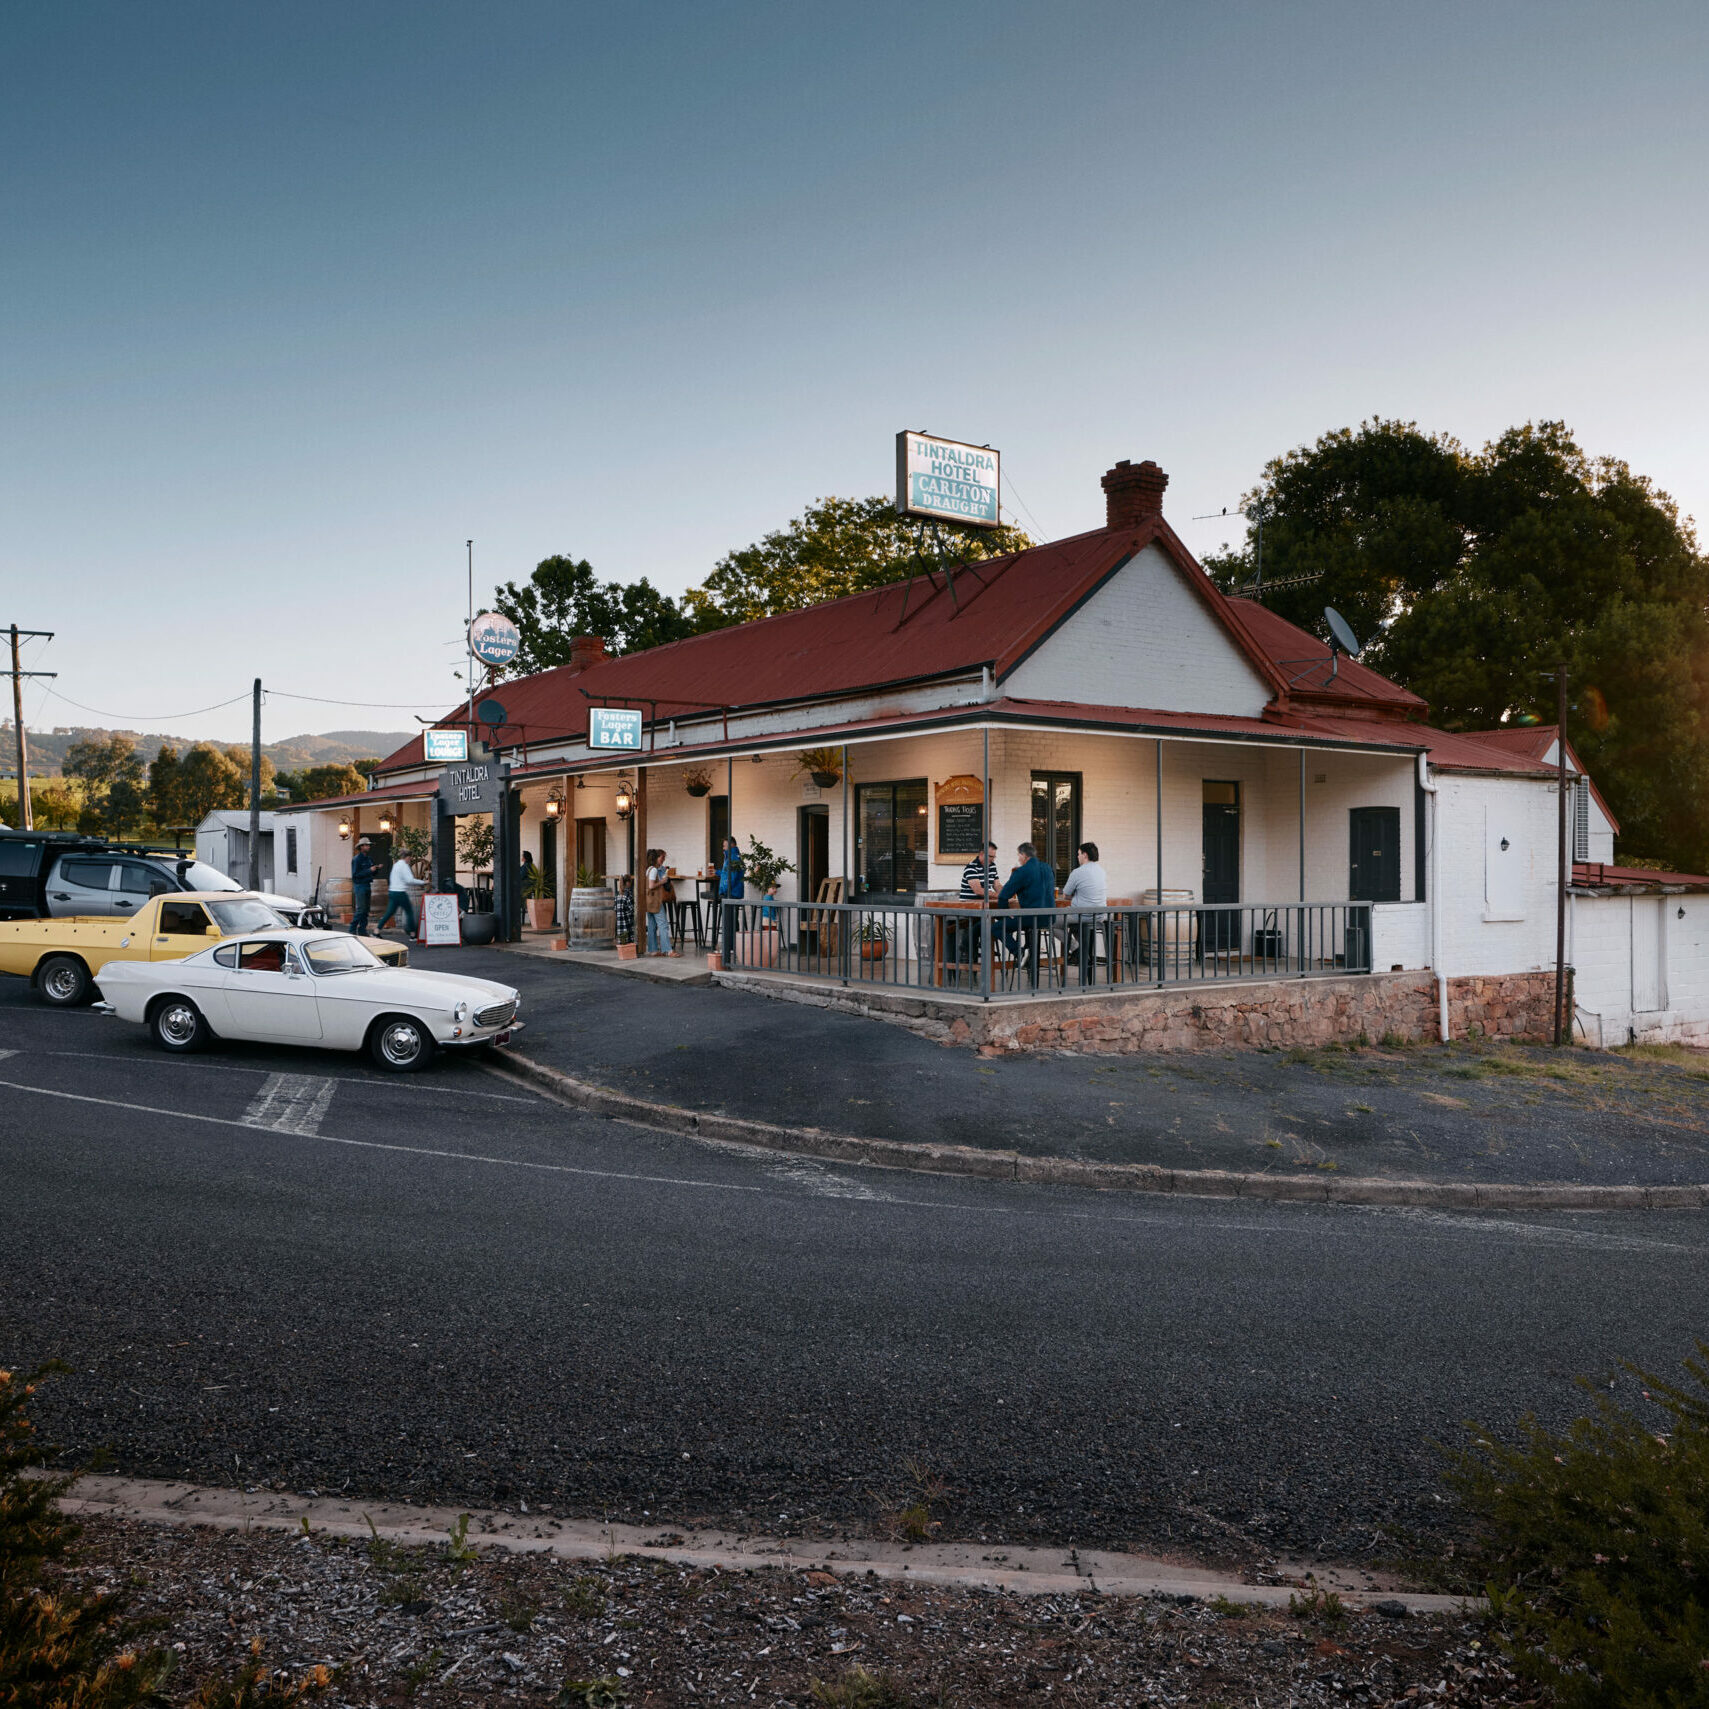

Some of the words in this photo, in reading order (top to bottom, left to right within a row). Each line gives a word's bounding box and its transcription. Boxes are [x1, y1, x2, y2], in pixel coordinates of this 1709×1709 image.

[914, 441, 994, 471] TINTALDRA
[931, 460, 980, 483] HOTEL
[919, 476, 991, 503] CARLTON
[922, 493, 988, 516] DRAUGHT
[480, 642, 513, 658] Lager
[597, 711, 637, 722] Fosters
[601, 720, 633, 732] Lager
[600, 731, 634, 745] BAR
[450, 765, 489, 786] TINTALDRA
[458, 784, 481, 802] HOTEL
